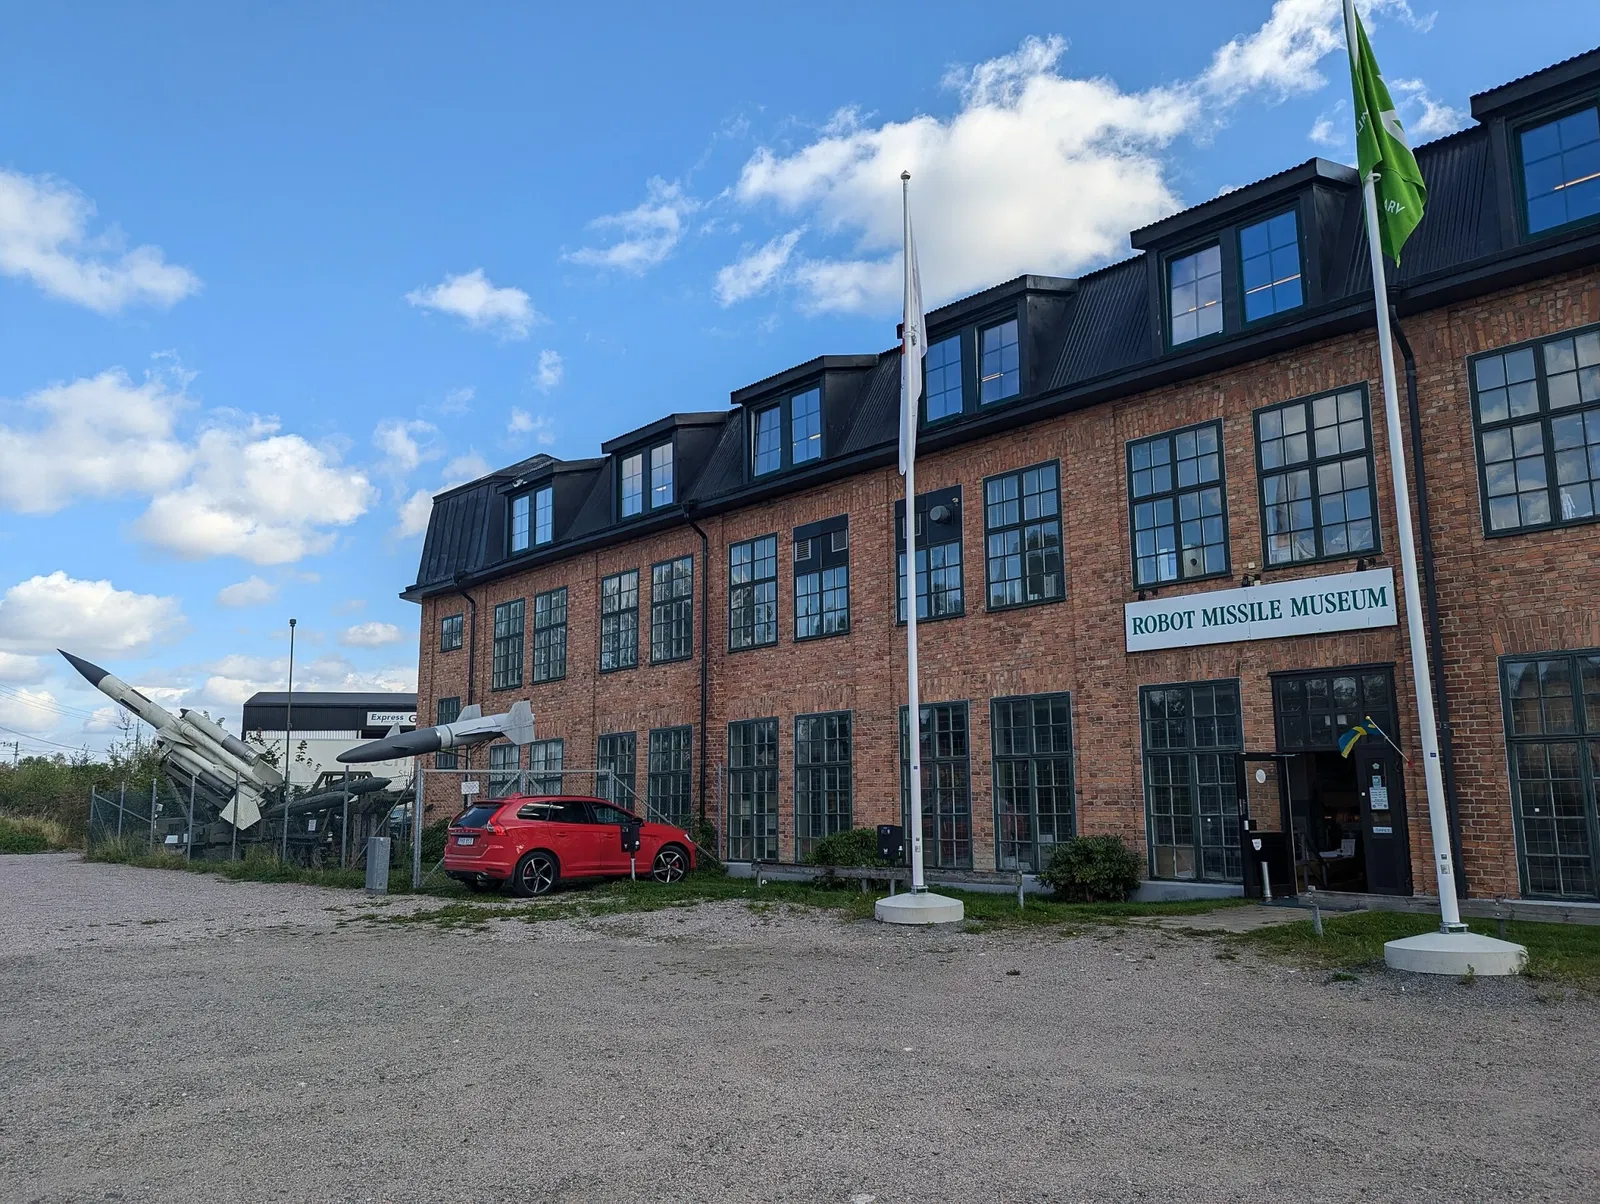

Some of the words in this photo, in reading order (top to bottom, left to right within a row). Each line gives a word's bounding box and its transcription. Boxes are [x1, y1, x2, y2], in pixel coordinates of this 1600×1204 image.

[1132, 610, 1196, 635] ROBOT
[1201, 599, 1283, 628] MISSILE
[1290, 586, 1388, 618] MUSEUM
[371, 713, 404, 723] Express
